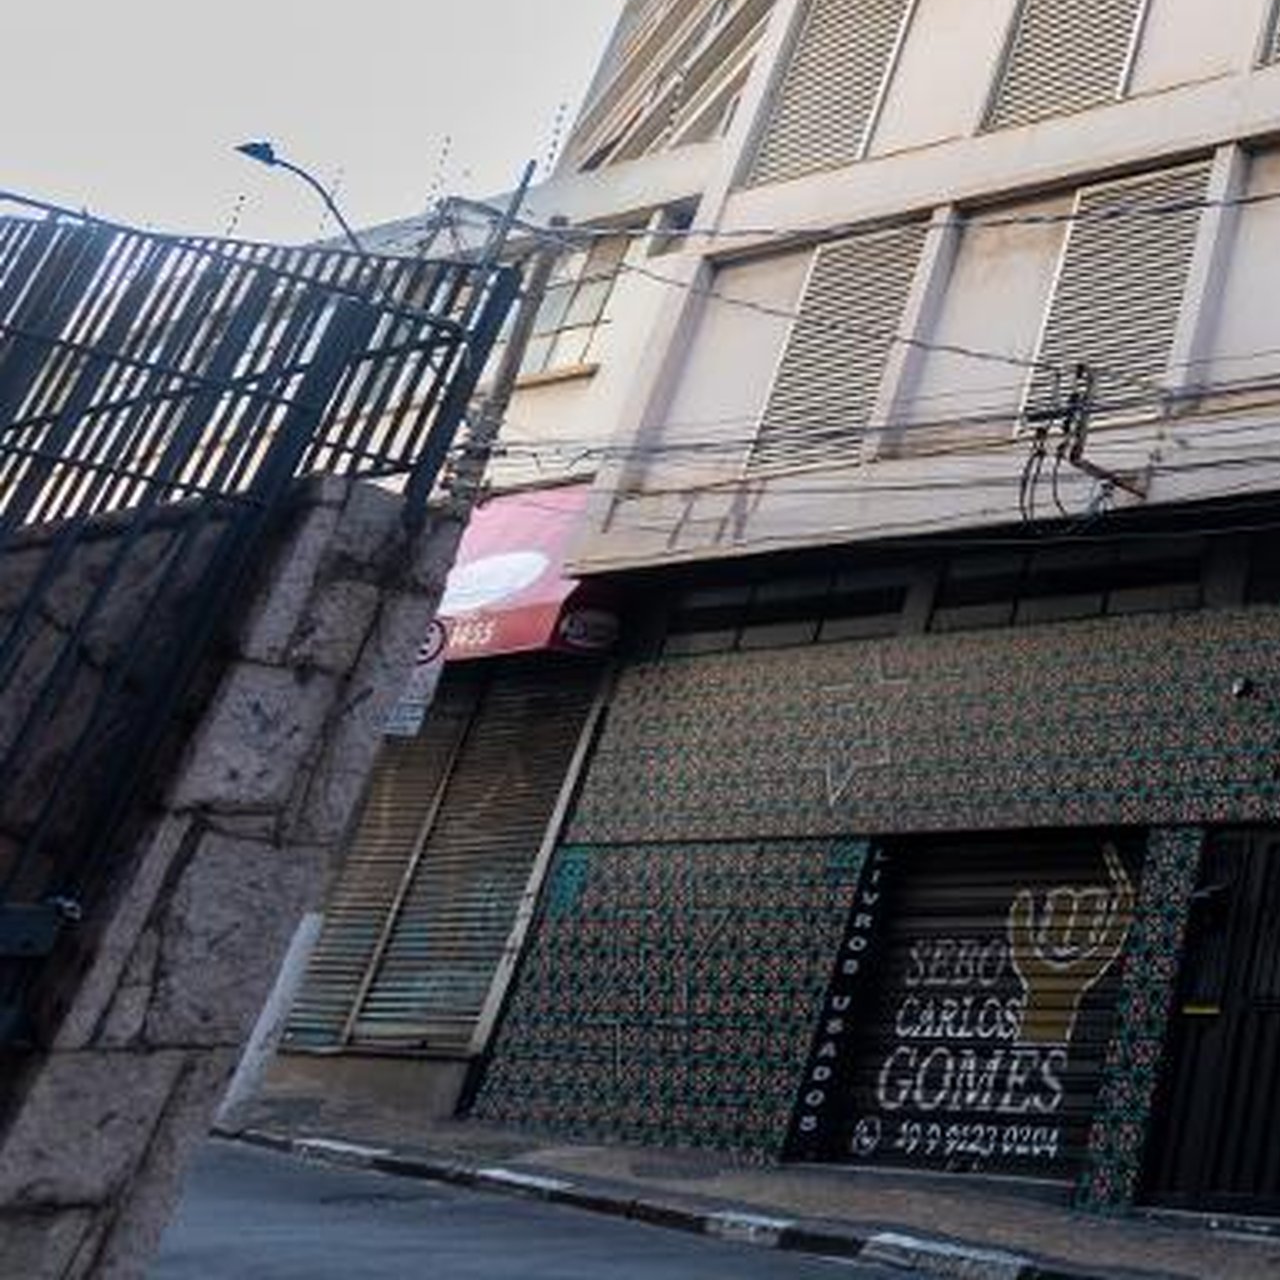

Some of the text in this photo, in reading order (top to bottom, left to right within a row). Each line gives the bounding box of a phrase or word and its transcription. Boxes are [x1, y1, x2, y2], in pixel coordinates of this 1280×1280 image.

[904, 936, 1010, 988] SEBO
[894, 995, 1023, 1041] CARLOS
[876, 1044, 1069, 1114] GOMES
